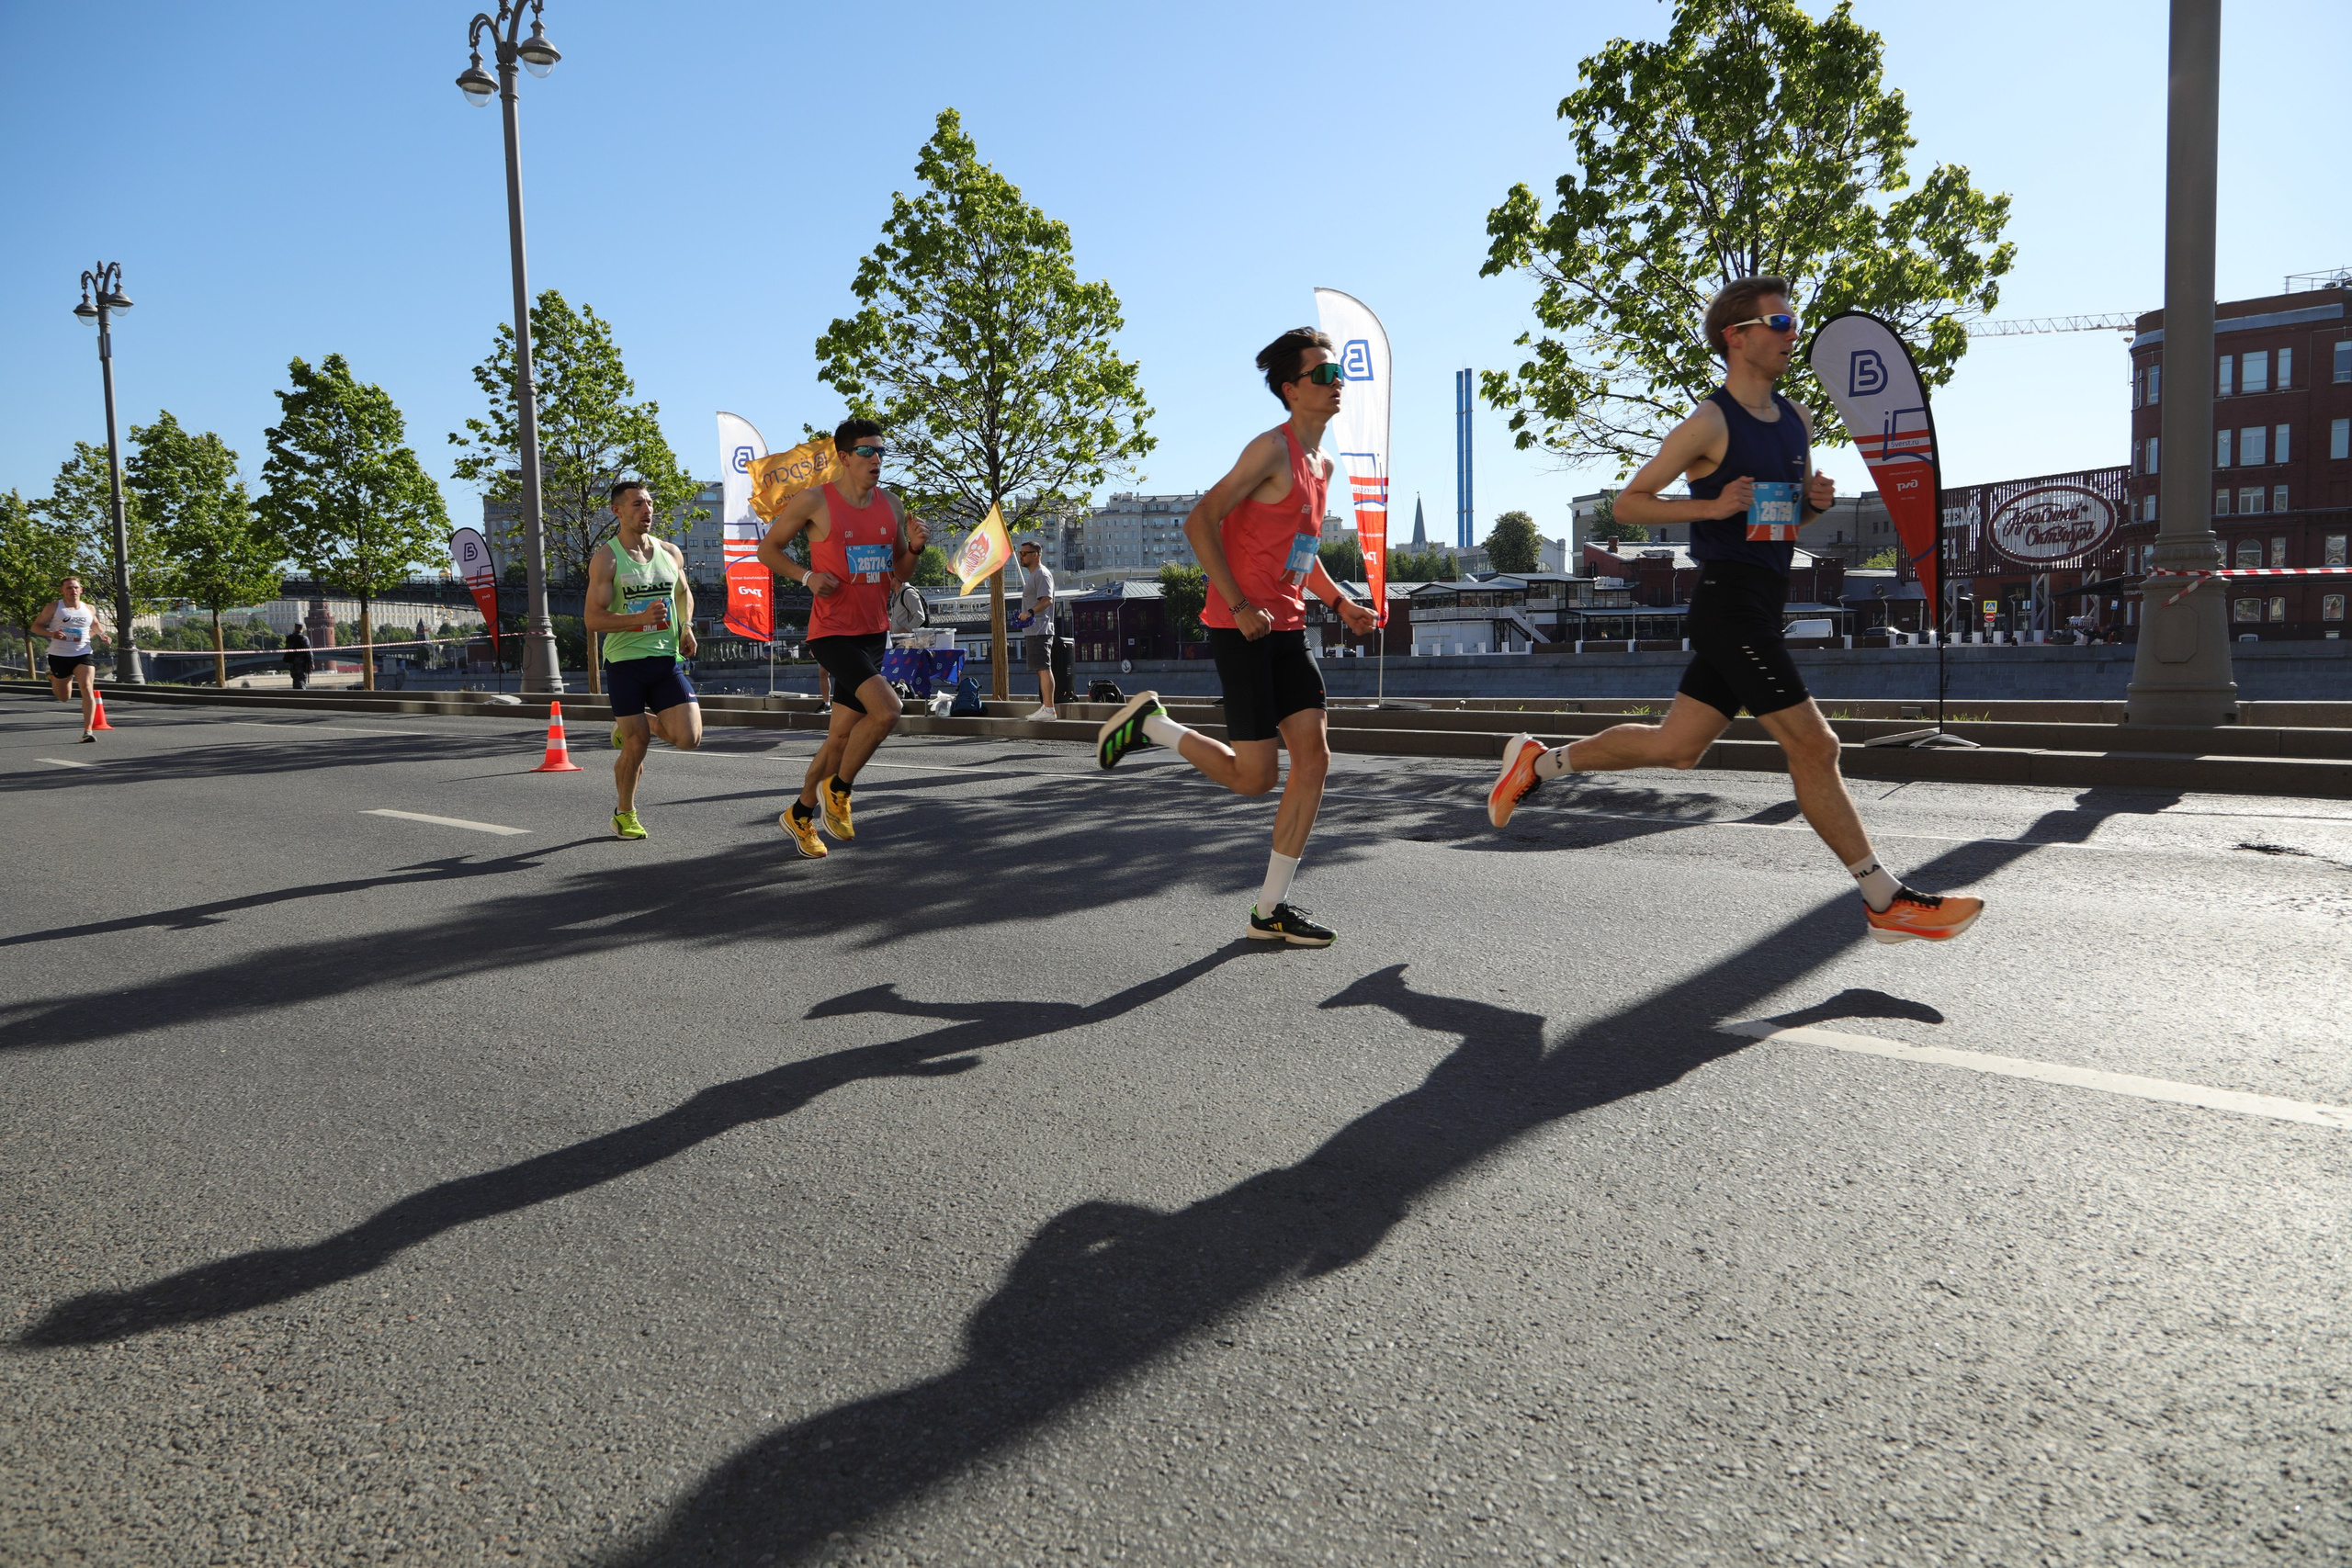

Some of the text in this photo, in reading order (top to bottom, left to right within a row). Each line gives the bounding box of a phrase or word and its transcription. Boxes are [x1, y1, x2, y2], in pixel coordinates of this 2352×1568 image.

[1942, 505, 1982, 528] НЕМЪ
[2026, 521, 2097, 552] Октябрь
[1942, 538, 1958, 559] 51
[857, 556, 887, 571] 26774
[865, 571, 881, 583] 5KM
